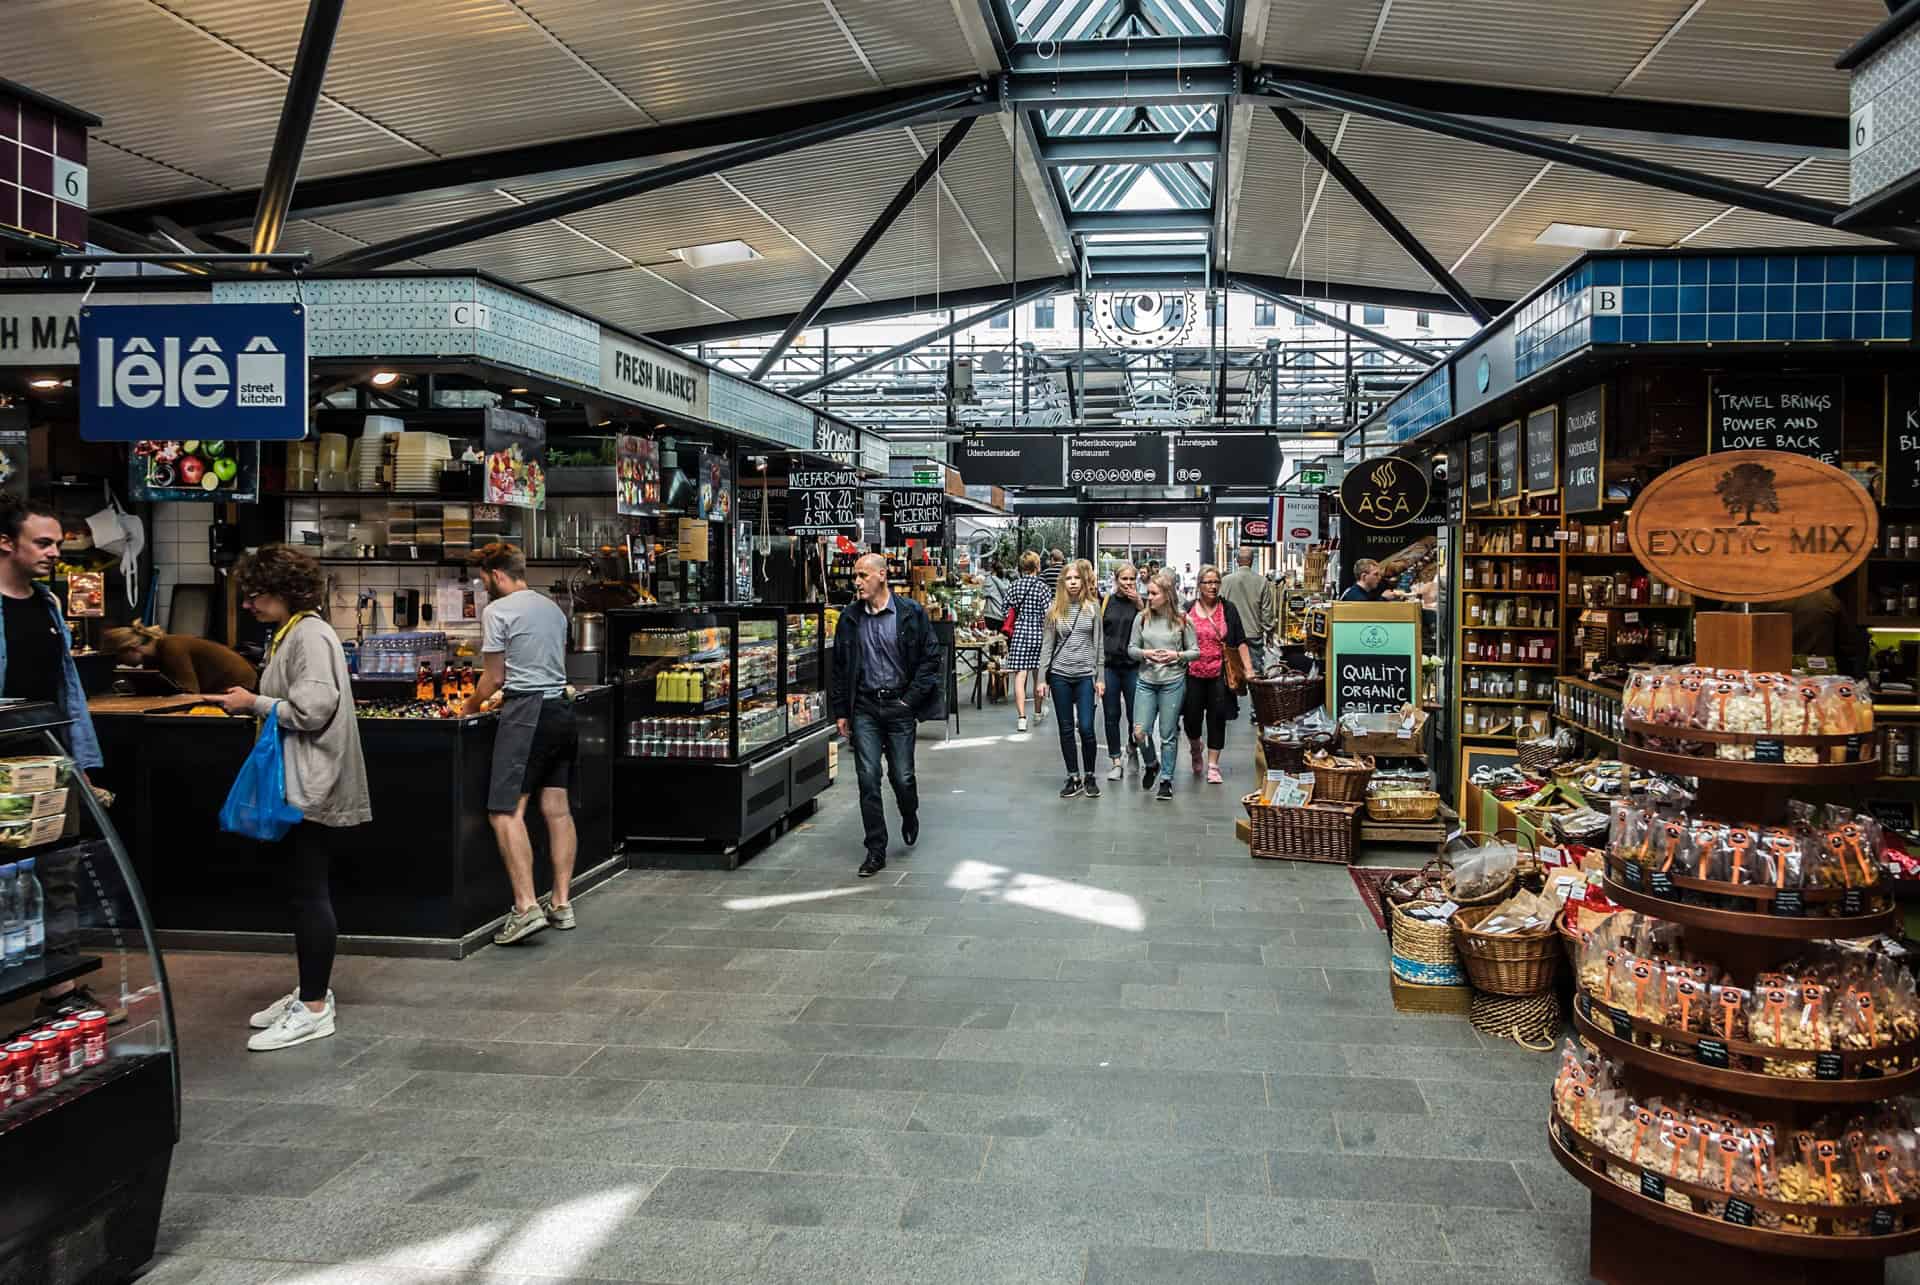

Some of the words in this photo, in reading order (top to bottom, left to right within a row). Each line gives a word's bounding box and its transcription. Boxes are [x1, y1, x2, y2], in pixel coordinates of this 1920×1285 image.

[1855, 114, 1866, 147] 6
[64, 170, 80, 198] 6
[1599, 290, 1617, 311] B
[454, 305, 469, 325] C
[32, 315, 80, 350] MA
[97, 335, 231, 409] lêlê
[615, 349, 653, 389] FRESH
[655, 375, 698, 409] MARKET
[240, 382, 275, 393] street
[240, 392, 283, 405] kitchen
[1718, 394, 1775, 411] TRAVEL
[1780, 393, 1832, 412] BRINGS
[1722, 417, 1777, 432] POWER
[1783, 416, 1819, 431] AND
[1071, 439, 1137, 449] Frederiksborggade
[1722, 436, 1768, 449] LOVE
[1775, 434, 1821, 449] BACK
[1071, 449, 1110, 457] Restaurant
[801, 492, 812, 510] 1
[814, 491, 834, 510] STK
[892, 491, 943, 509] GLUTENFRI
[804, 511, 813, 525] 6
[814, 510, 834, 525] STK
[893, 506, 943, 523] MEJERIFRI
[1647, 527, 1771, 557] EXOTIC
[1788, 524, 1856, 555] MIX
[1342, 663, 1408, 683] QUALITY
[1341, 683, 1408, 702] ORGANIC
